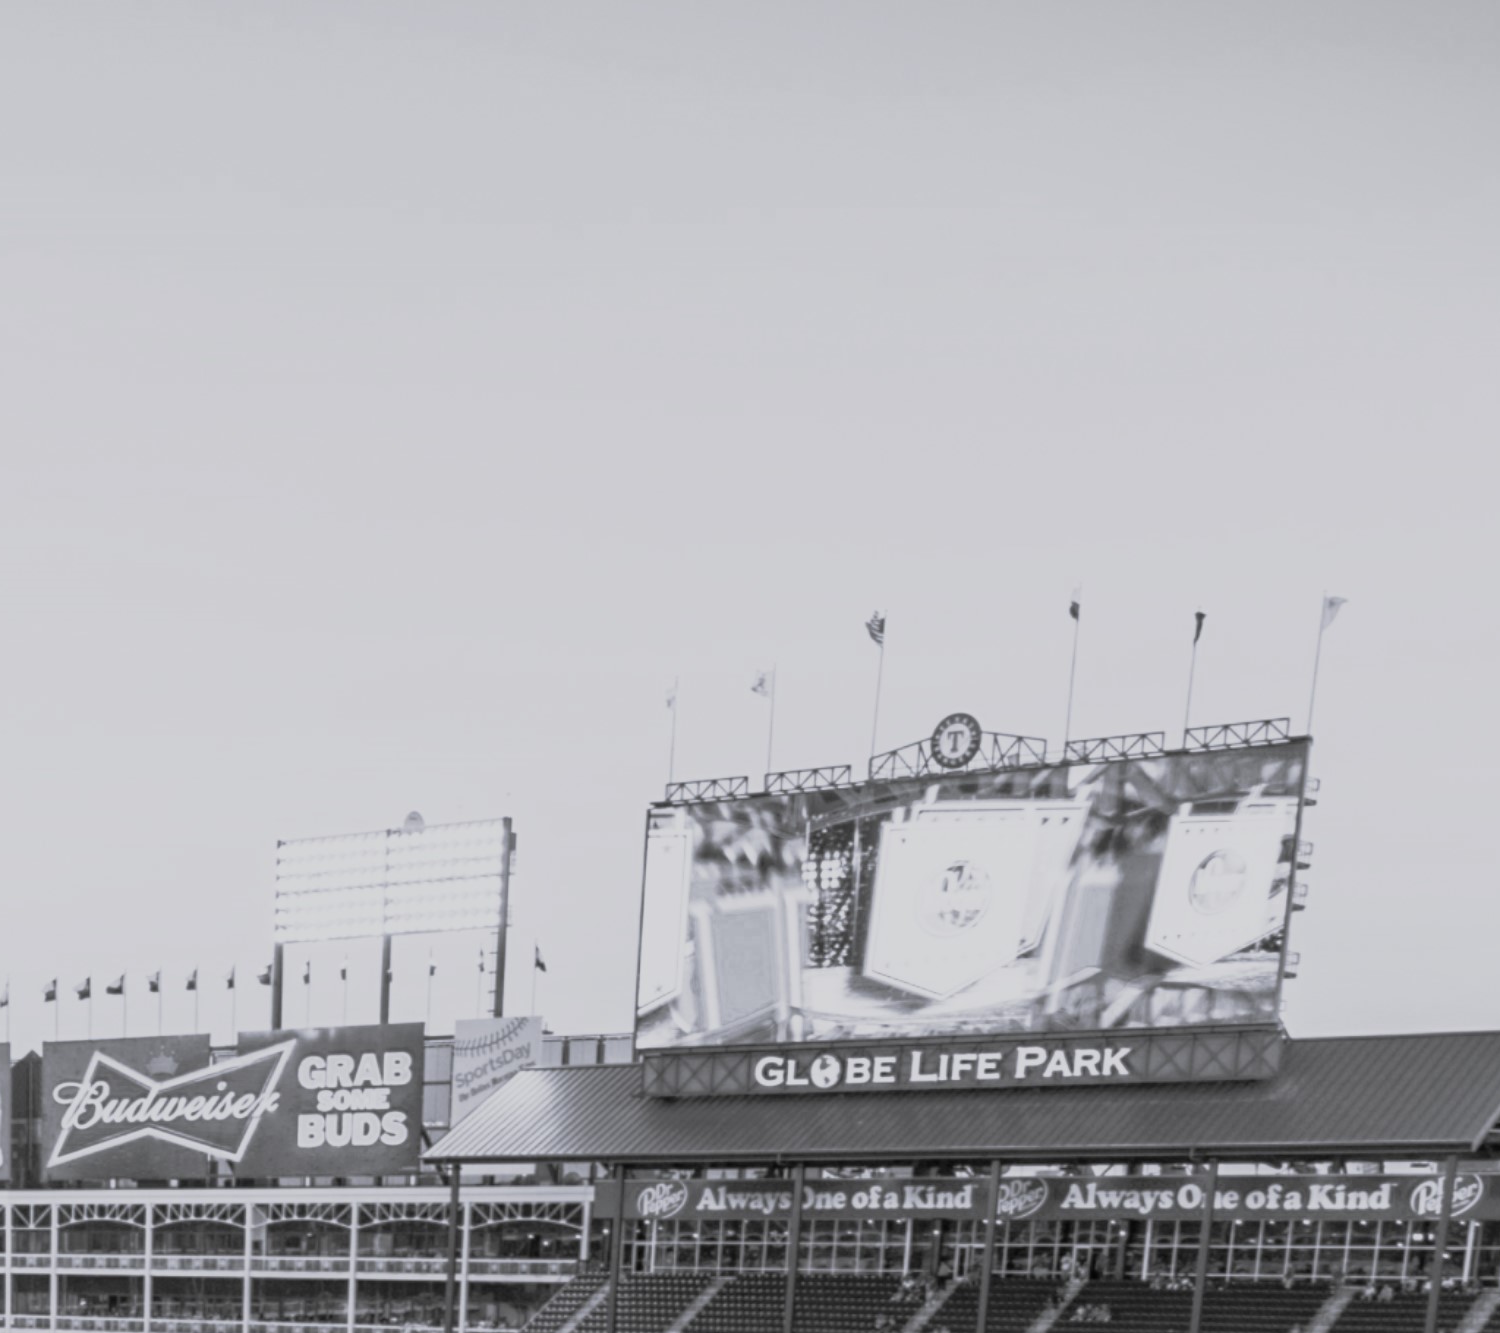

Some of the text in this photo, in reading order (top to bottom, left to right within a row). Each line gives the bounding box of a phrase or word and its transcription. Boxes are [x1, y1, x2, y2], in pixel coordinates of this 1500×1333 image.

[297, 1051, 413, 1090] GRAB
[753, 1045, 1132, 1090] GLOBE LIFE PARK
[53, 1080, 281, 1130] Budweiser
[316, 1087, 391, 1112] SOME
[296, 1111, 408, 1148] BUDS
[639, 1188, 685, 1216] Pepper
[696, 1187, 793, 1214] Always
[851, 1185, 882, 1210] of
[882, 1191, 899, 1210] a
[903, 1184, 973, 1210] Kind
[1060, 1184, 1173, 1215] Always
[1244, 1184, 1282, 1211] of
[1282, 1190, 1301, 1211] a
[1305, 1183, 1390, 1211] Kind
